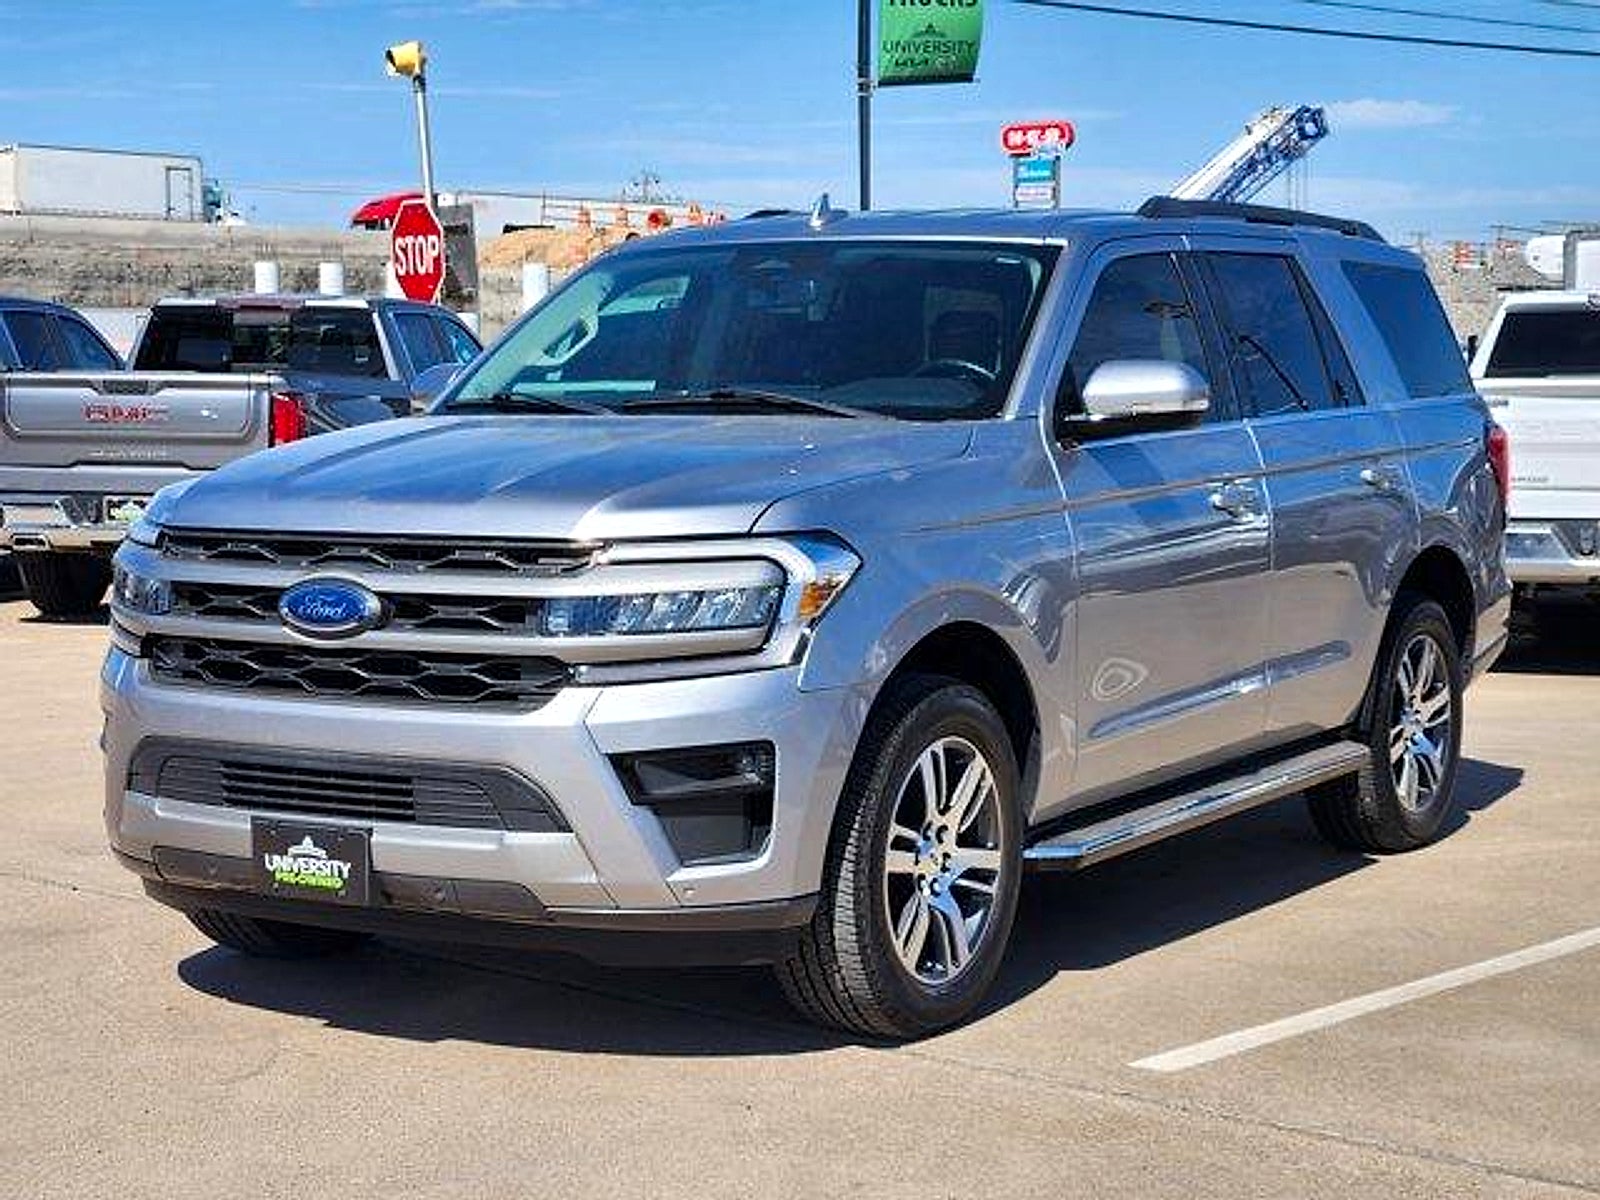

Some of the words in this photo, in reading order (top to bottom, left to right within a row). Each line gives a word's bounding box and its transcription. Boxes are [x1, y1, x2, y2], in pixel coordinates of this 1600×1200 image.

[882, 40, 977, 55] UNIVERSITY
[395, 235, 440, 276] STOP
[300, 595, 347, 618] Ford
[264, 853, 352, 879] UNIVERSITY
